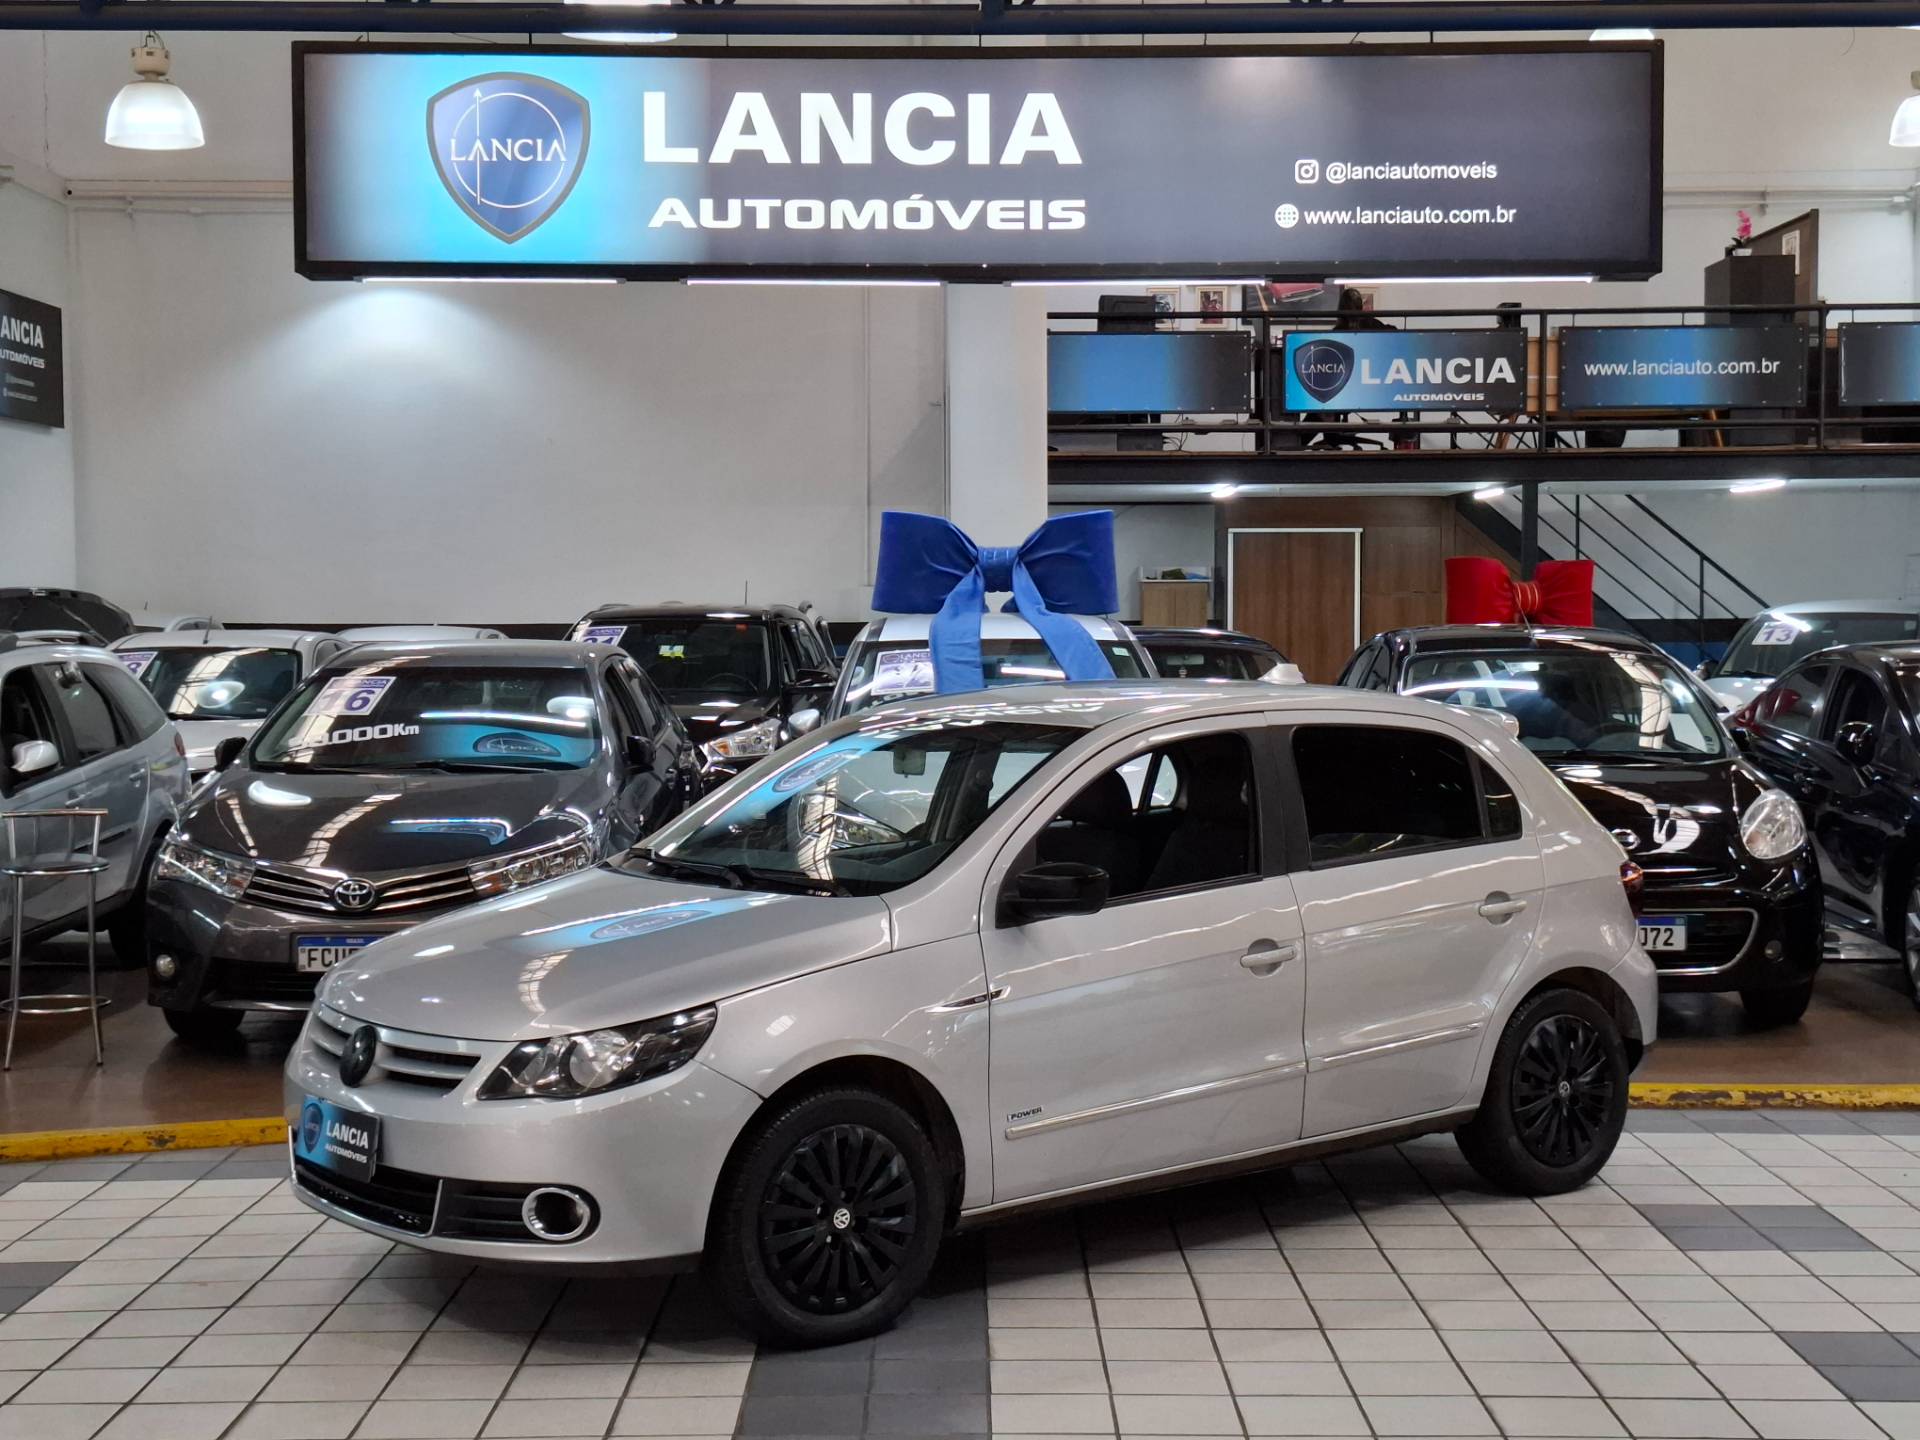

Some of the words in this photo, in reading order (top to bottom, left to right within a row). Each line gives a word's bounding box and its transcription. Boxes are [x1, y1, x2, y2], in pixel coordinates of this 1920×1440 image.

[643, 91, 1083, 165] LANCIA
[450, 137, 567, 162] LANCIA
[1325, 160, 1499, 185] @lanciautomoveis
[647, 193, 1086, 231] AUTOMÓVEIS
[1303, 204, 1517, 225] www.lanciauto.com.br
[0, 315, 44, 349] ANCIA
[0, 347, 46, 369] UTOMÓVEIS
[1300, 363, 1346, 375] LANCIA
[1583, 357, 1781, 377] www.lanciauto.com.br
[1360, 357, 1517, 385] LANCIA
[1393, 391, 1486, 402] AUTOMÓVEIS
[1010, 1106, 1043, 1120] POWER
[326, 1119, 369, 1150] LANCIA
